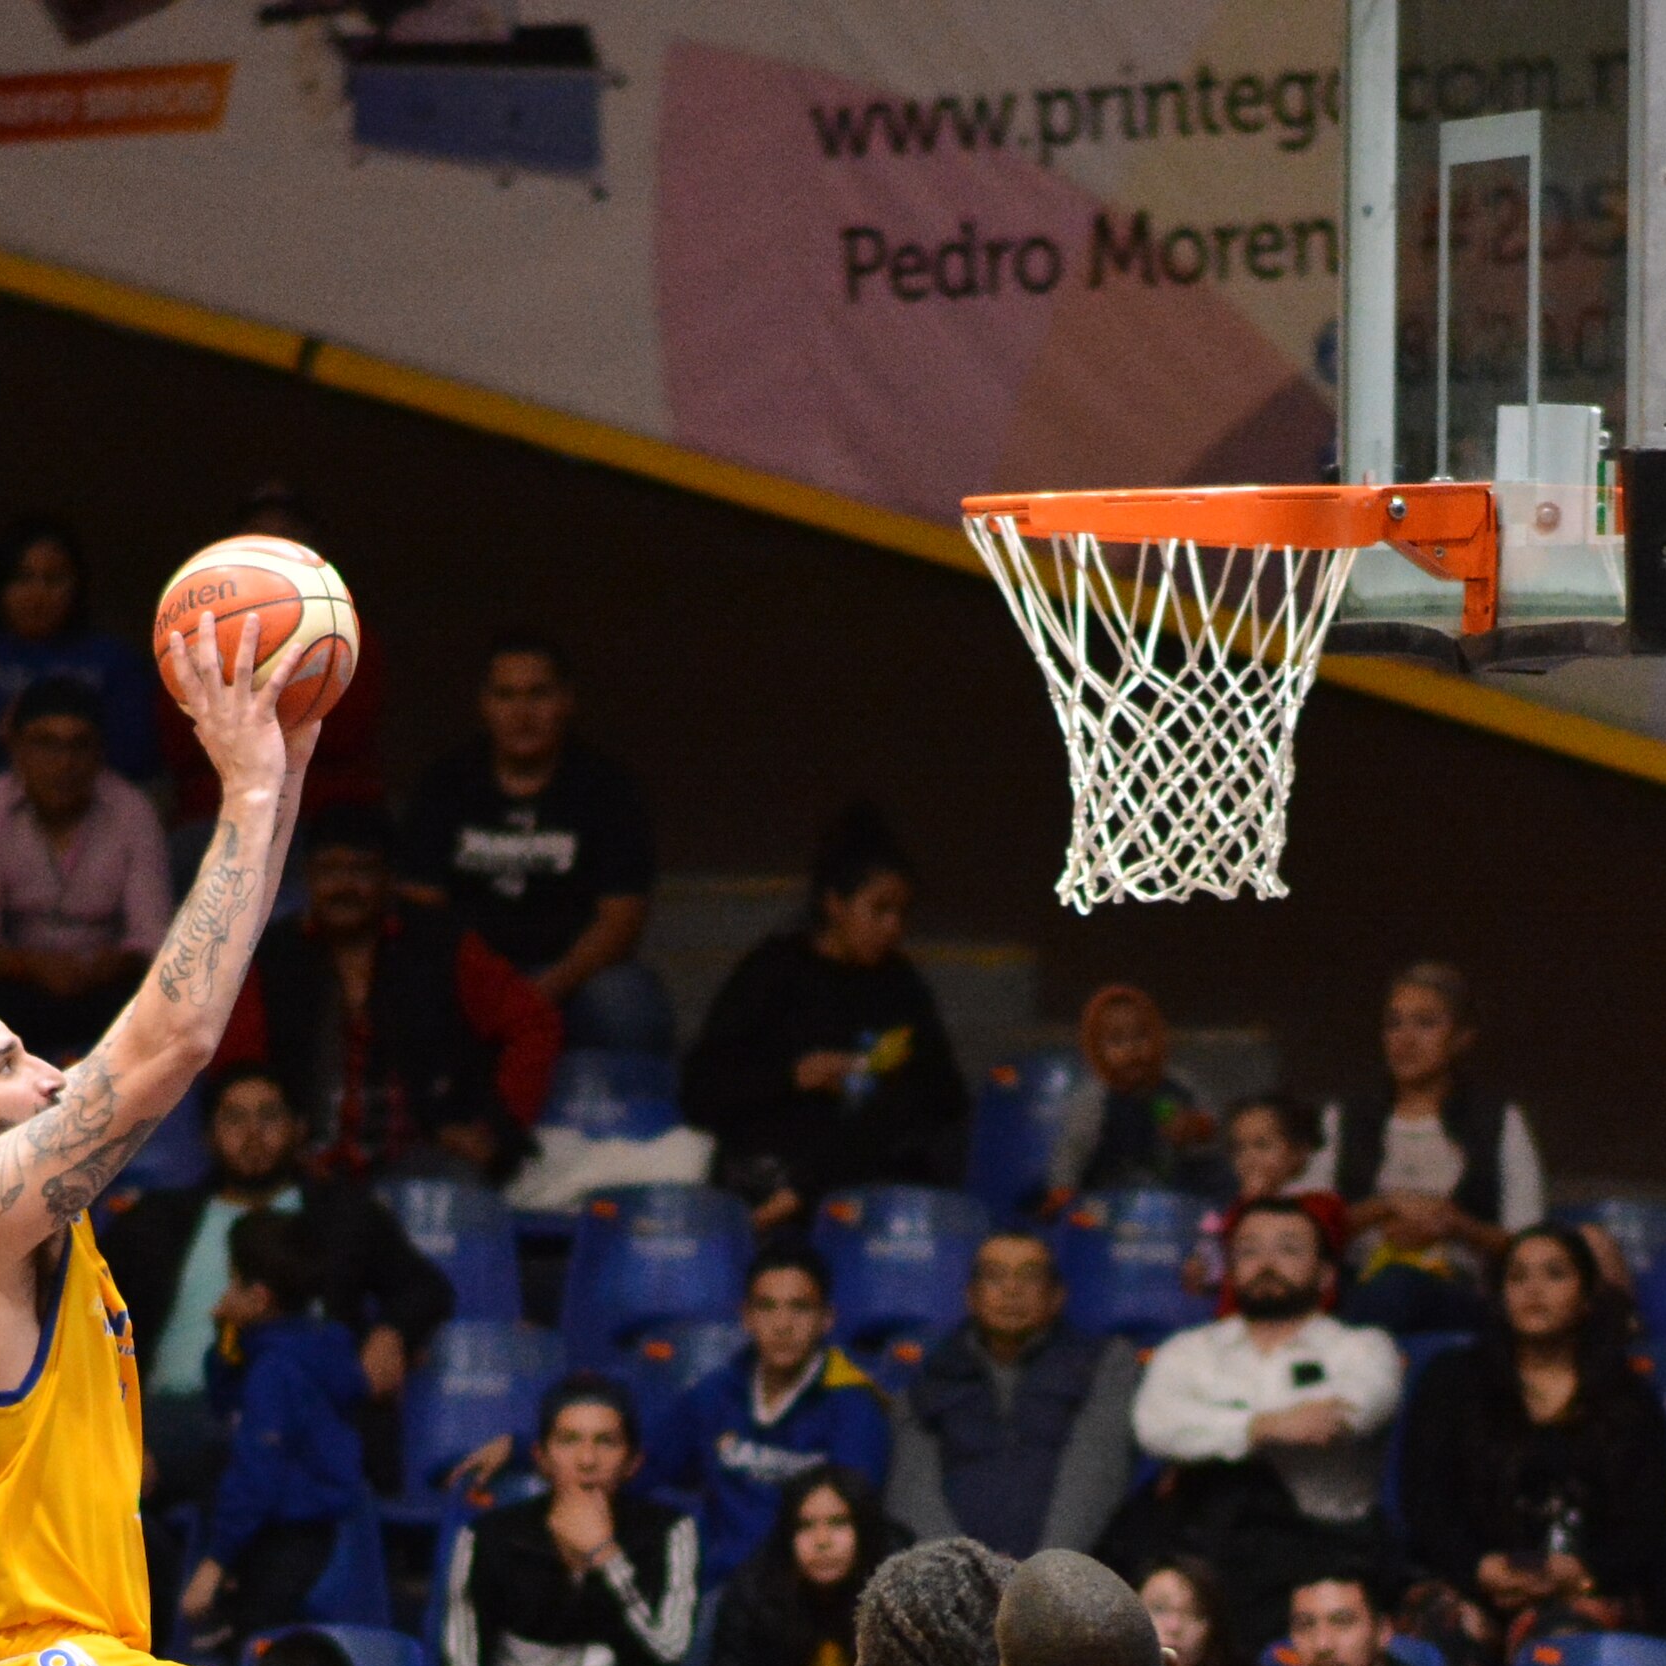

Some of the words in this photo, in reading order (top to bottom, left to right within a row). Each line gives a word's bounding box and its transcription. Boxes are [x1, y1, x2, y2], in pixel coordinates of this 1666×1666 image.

[842, 216, 1061, 300] Pedro
[1088, 210, 1338, 290] Moren
[156, 579, 238, 637] molten
